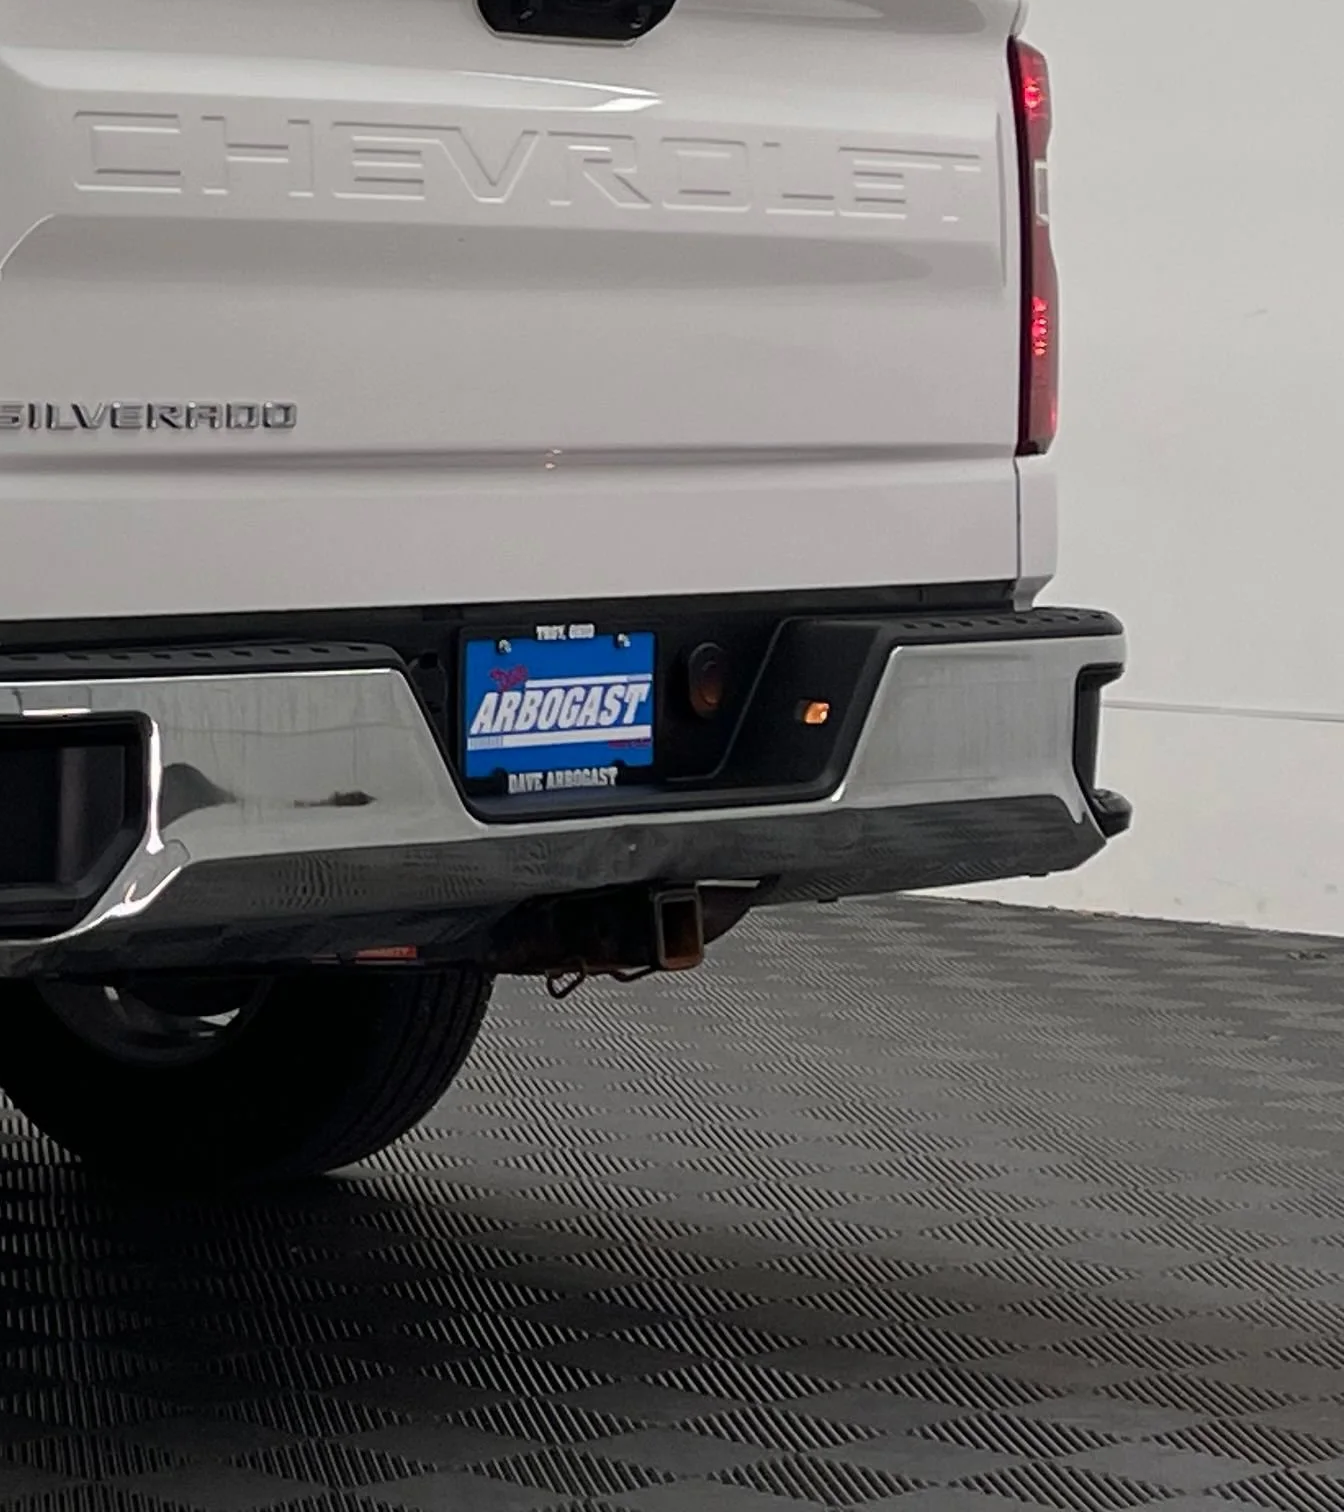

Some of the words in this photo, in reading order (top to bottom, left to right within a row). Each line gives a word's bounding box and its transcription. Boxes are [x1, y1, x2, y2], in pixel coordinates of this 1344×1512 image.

[72, 109, 982, 223] CHEVROLET
[469, 682, 651, 735] ARBOGAST
[508, 772, 544, 795] DAVE
[545, 766, 619, 790] ARBOGAST
